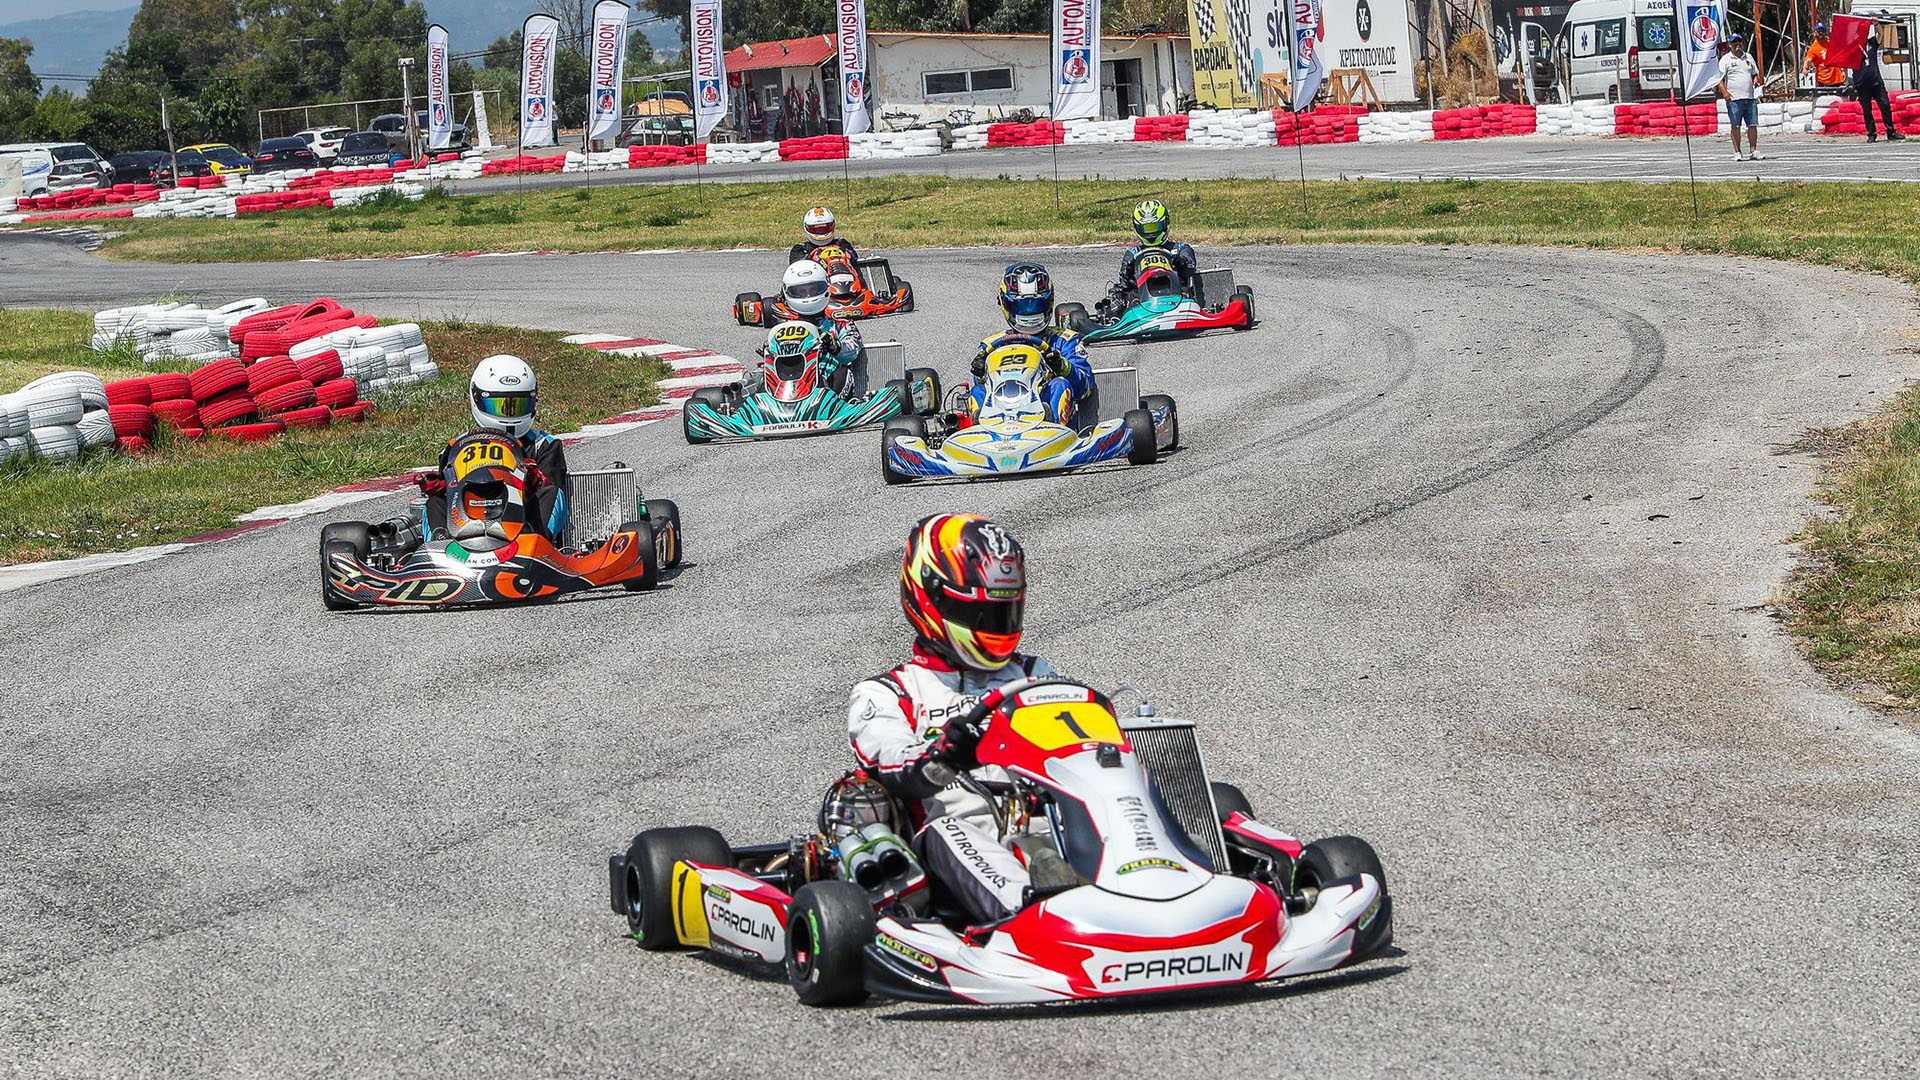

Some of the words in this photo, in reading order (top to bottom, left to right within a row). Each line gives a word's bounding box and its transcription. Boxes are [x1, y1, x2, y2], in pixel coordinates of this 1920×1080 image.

[697, 9, 713, 77] AUTOVISION
[1266, 11, 1288, 48] SK
[527, 36, 546, 96] AUTOVISION
[597, 22, 615, 87] AUTOVISION
[1194, 46, 1232, 71] BARDAHL
[1339, 46, 1396, 68] ΧΡΙΣΤΟΠΟΥΛΟΣ
[431, 46, 444, 103] AUTOVISION
[1144, 256, 1167, 266] 308
[776, 325, 806, 339] 309
[999, 353, 1028, 367] 23
[501, 376, 519, 385] Arai
[463, 445, 503, 463] 310
[1054, 711, 1091, 739] 1
[678, 869, 689, 938] 1
[879, 934, 935, 967] MODENA
[1124, 951, 1244, 982] PAROLIN
